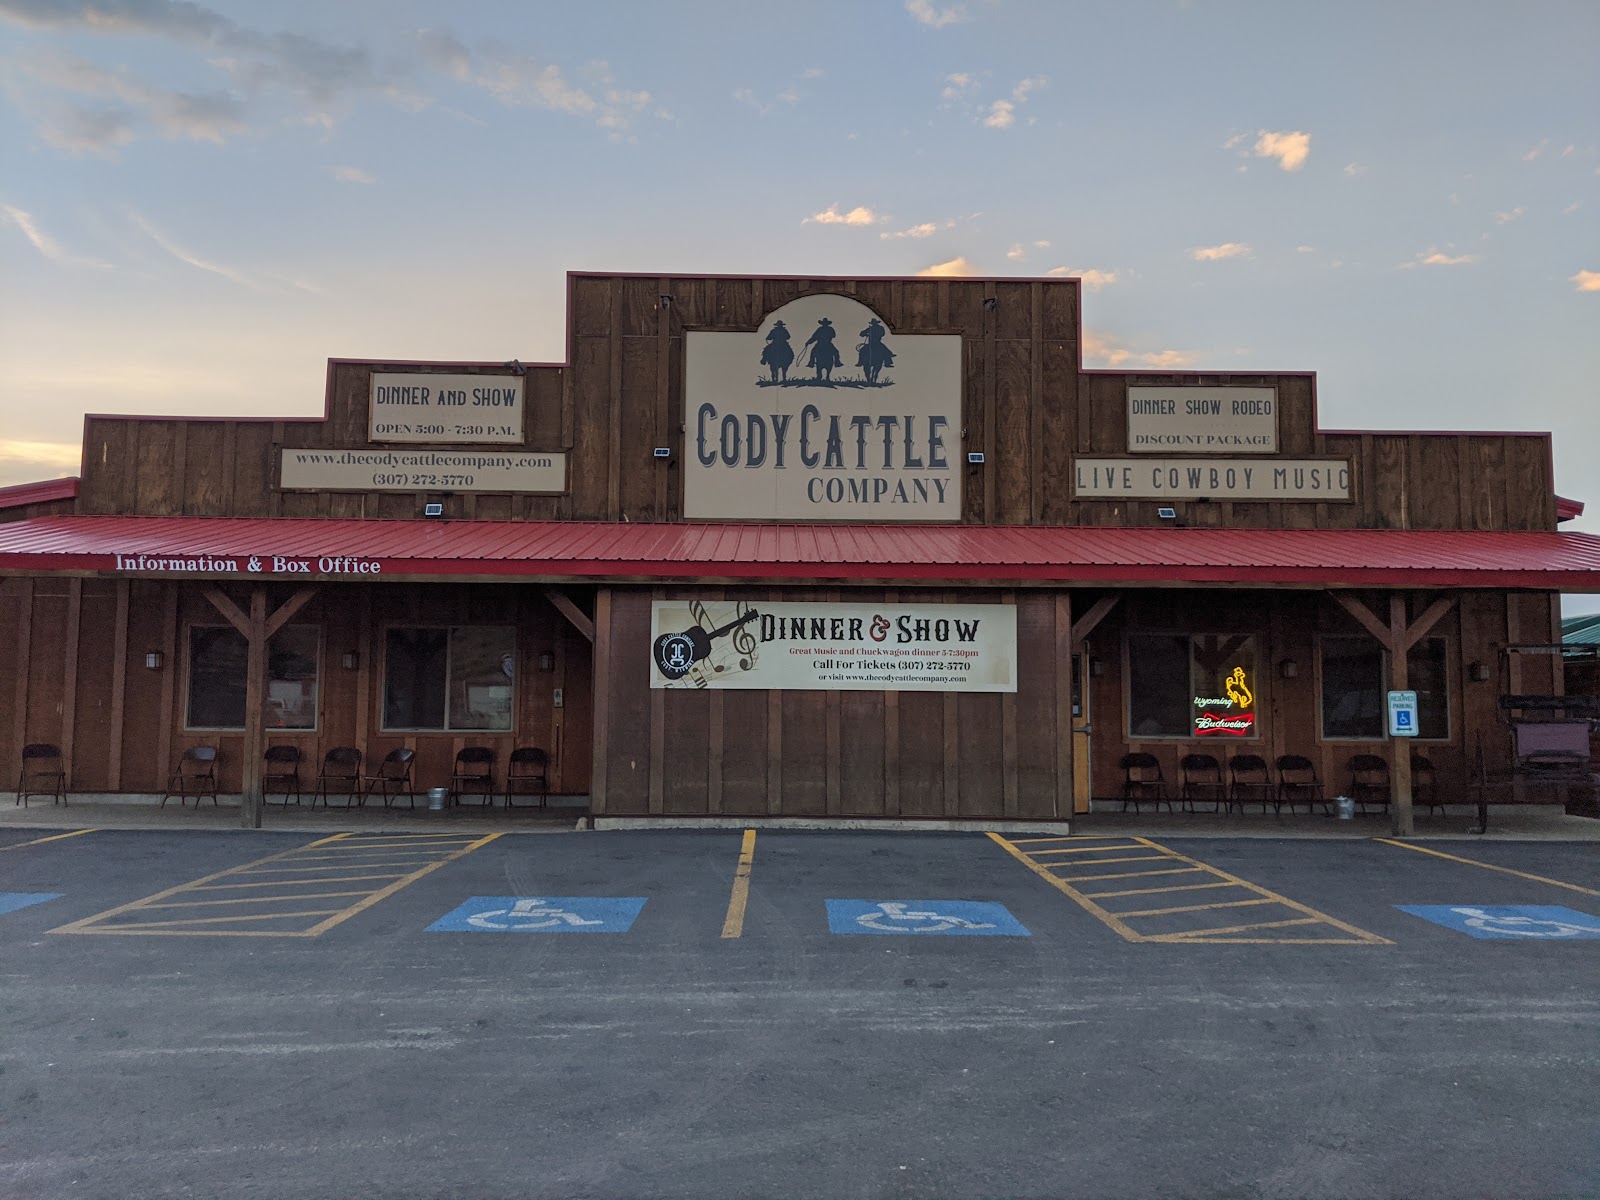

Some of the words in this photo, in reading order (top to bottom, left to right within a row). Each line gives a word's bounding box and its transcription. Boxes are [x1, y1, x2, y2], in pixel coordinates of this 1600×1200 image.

[376, 386, 430, 406] DINNER
[437, 390, 467, 406] AND
[472, 388, 516, 407] SHOW
[1132, 399, 1176, 415] DINNER
[1185, 399, 1221, 415] SHOW
[1232, 400, 1272, 416] RODEO
[375, 423, 412, 434] OPEN
[415, 424, 445, 435] 5:00
[454, 424, 483, 435] 7:30
[487, 425, 516, 436] P.M.
[696, 402, 794, 469] CODY
[799, 404, 950, 470] CATTLE
[1135, 434, 1204, 445] DISCOUNT
[1206, 434, 1271, 445] PACKAGE
[296, 452, 552, 470] www.thecodycattlecompany.com
[372, 473, 408, 487] (307)
[412, 473, 474, 487] 272-5770
[1076, 466, 1133, 490] LIVE
[1152, 467, 1253, 490] COWBOY
[1273, 467, 1349, 490] MUSIC
[807, 477, 951, 504] COMPANY
[115, 554, 238, 572] Information
[247, 556, 263, 573] &
[272, 556, 310, 573] Box
[318, 556, 381, 574] Office
[760, 613, 864, 643] DINNER
[869, 614, 891, 642] &
[895, 614, 981, 643] SHOW
[789, 647, 812, 655] Great
[813, 647, 838, 655] Music
[838, 647, 855, 655] and
[856, 647, 910, 657] Chuckwagon
[911, 648, 941, 656] dinner
[941, 649, 979, 658] 5-7:30pm
[813, 659, 833, 669] Call
[836, 660, 855, 669] For
[856, 660, 896, 670] Tickets
[898, 660, 924, 671] (307)
[926, 661, 971, 671] 272-5770
[828, 673, 844, 681] visit
[845, 674, 967, 684] www.thecodycattlecompany.com
[1193, 696, 1233, 709] Wyoming
[1195, 717, 1252, 729] Budweiser
